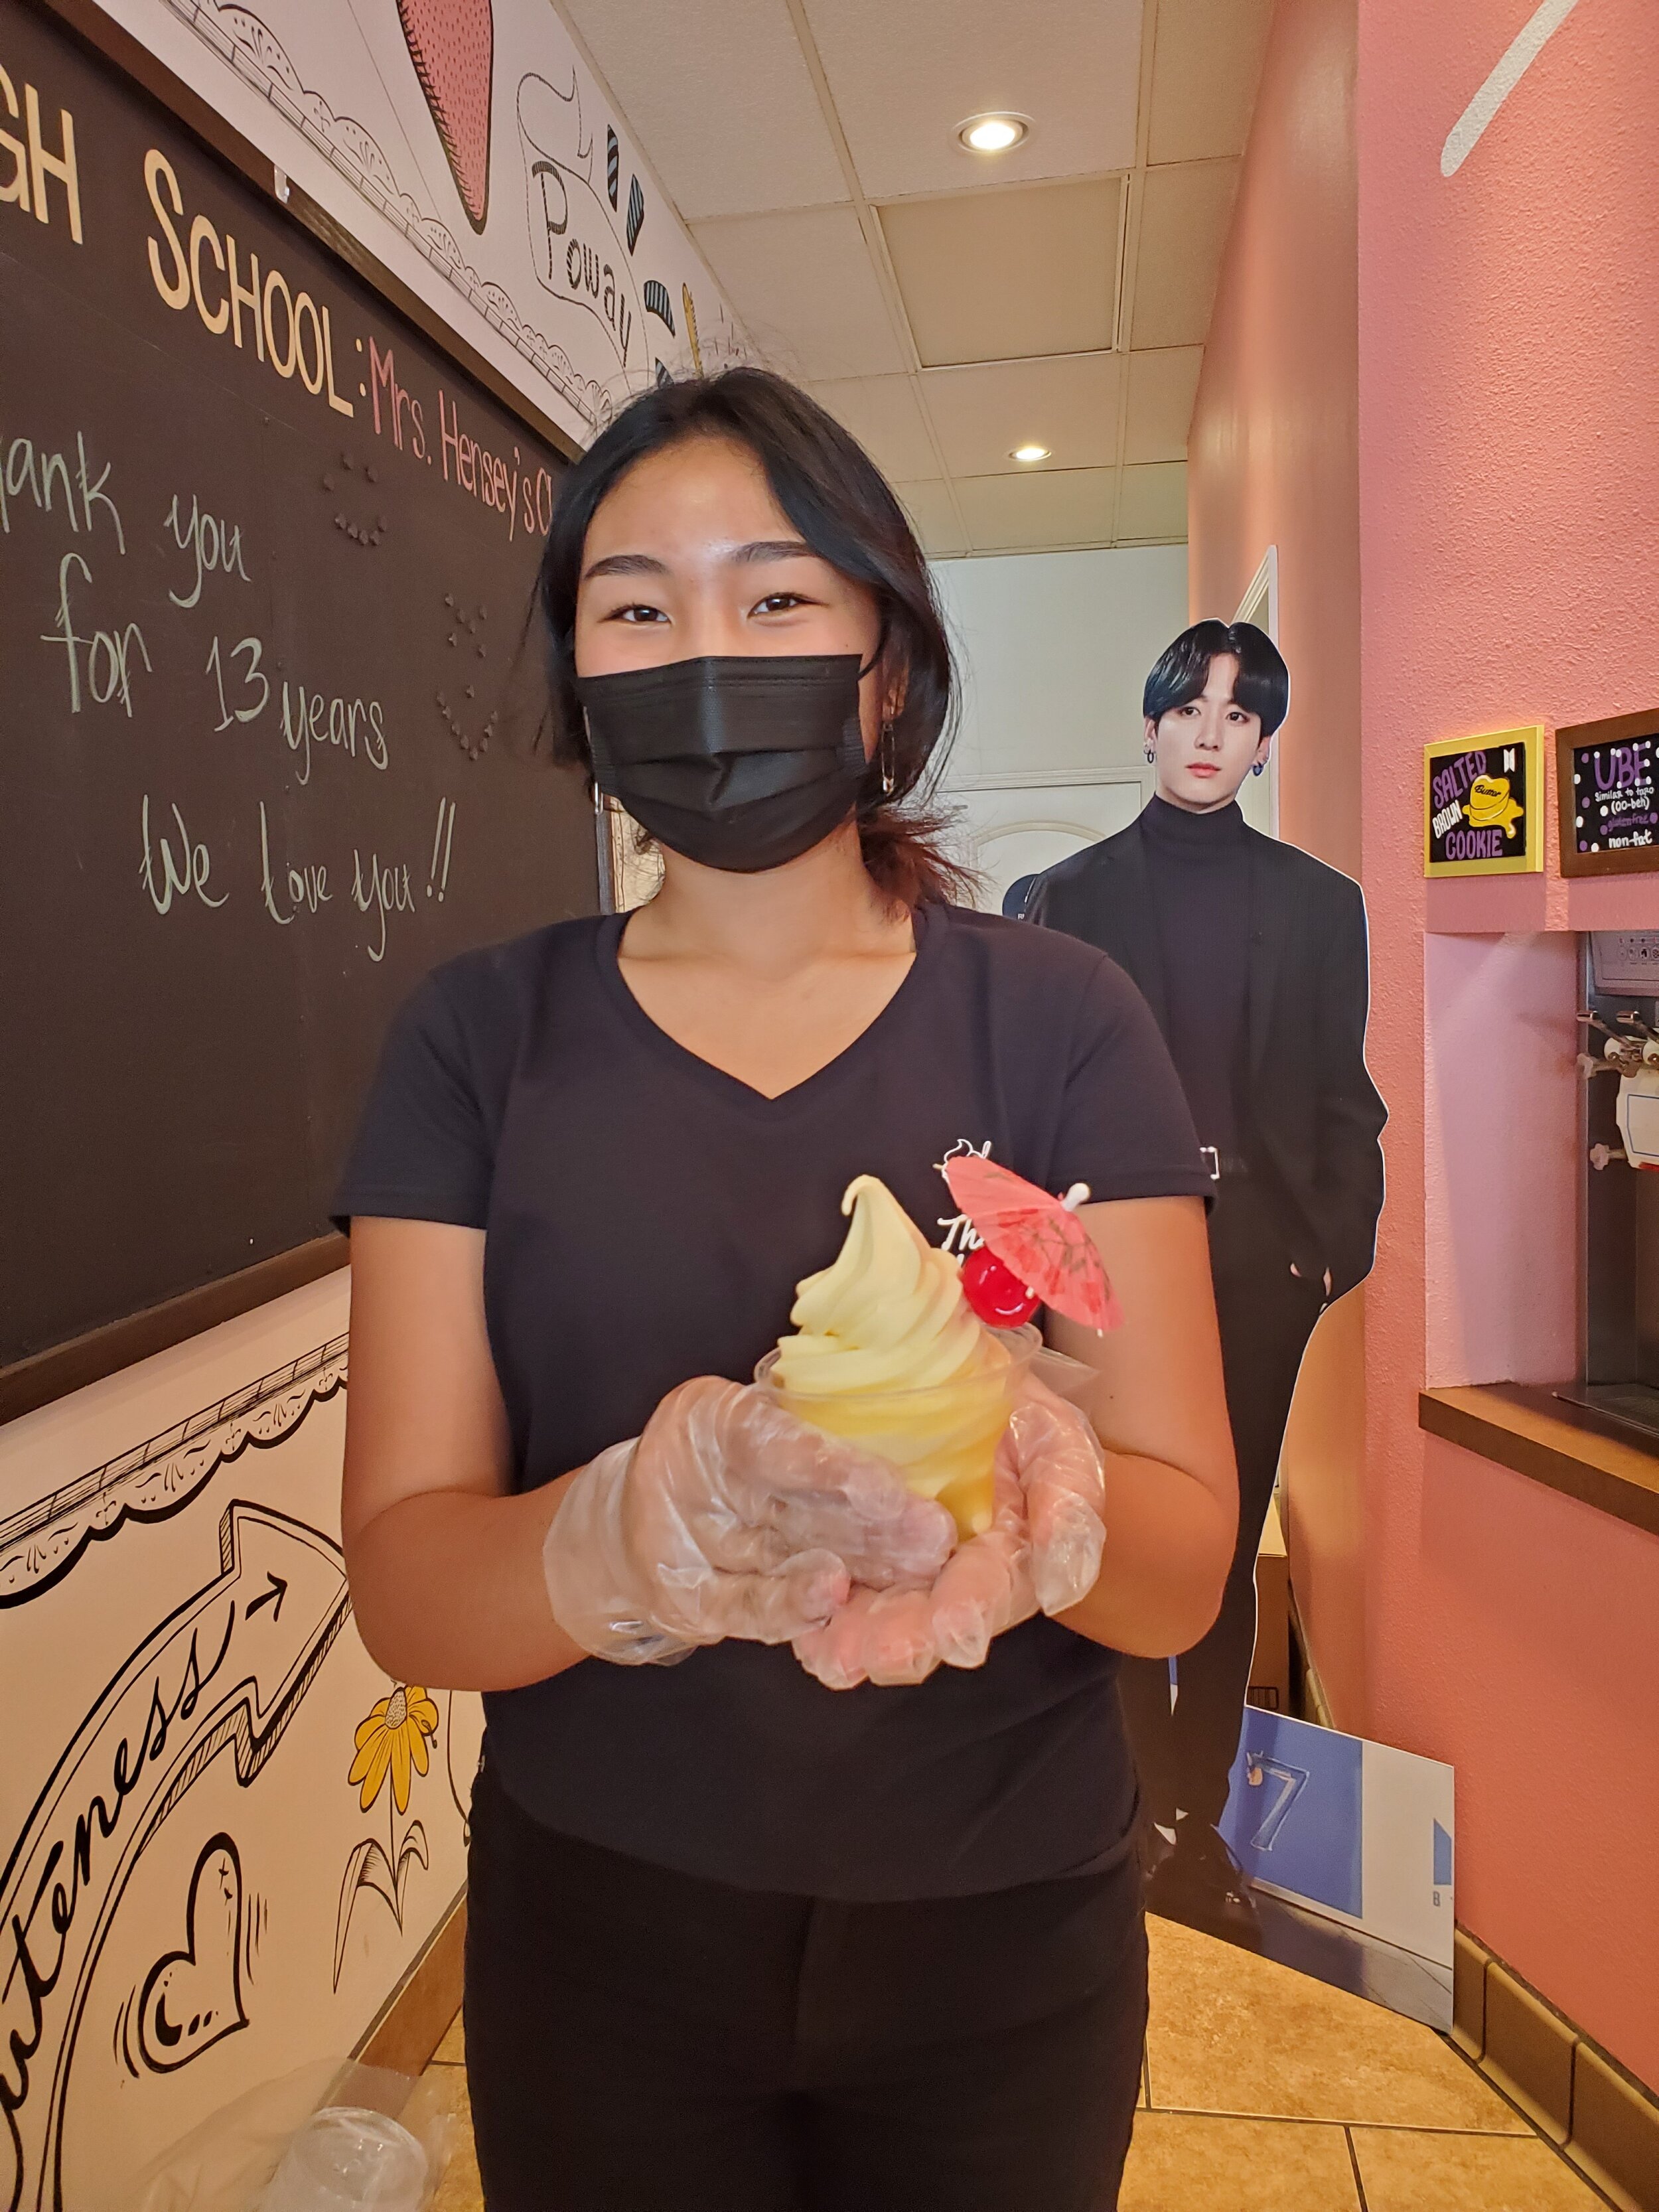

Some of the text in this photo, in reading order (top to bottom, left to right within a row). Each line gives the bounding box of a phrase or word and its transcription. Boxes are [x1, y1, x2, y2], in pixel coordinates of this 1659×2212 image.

[532, 161, 631, 368] Poway
[369, 335, 432, 465] Mrs.
[40, 552, 389, 786] for 13 years
[1432, 751, 1487, 809] SALTED
[1593, 741, 1652, 790] UBE
[1474, 784, 1502, 797] Butter
[1624, 787, 1634, 796] to
[1431, 799, 1463, 840] BROWN
[1608, 829, 1653, 849] non-fat
[138, 794, 230, 915] We
[1445, 830, 1504, 861] COOKIE
[937, 1214, 985, 1251] Th
[0, 1599, 236, 2212] uteness
